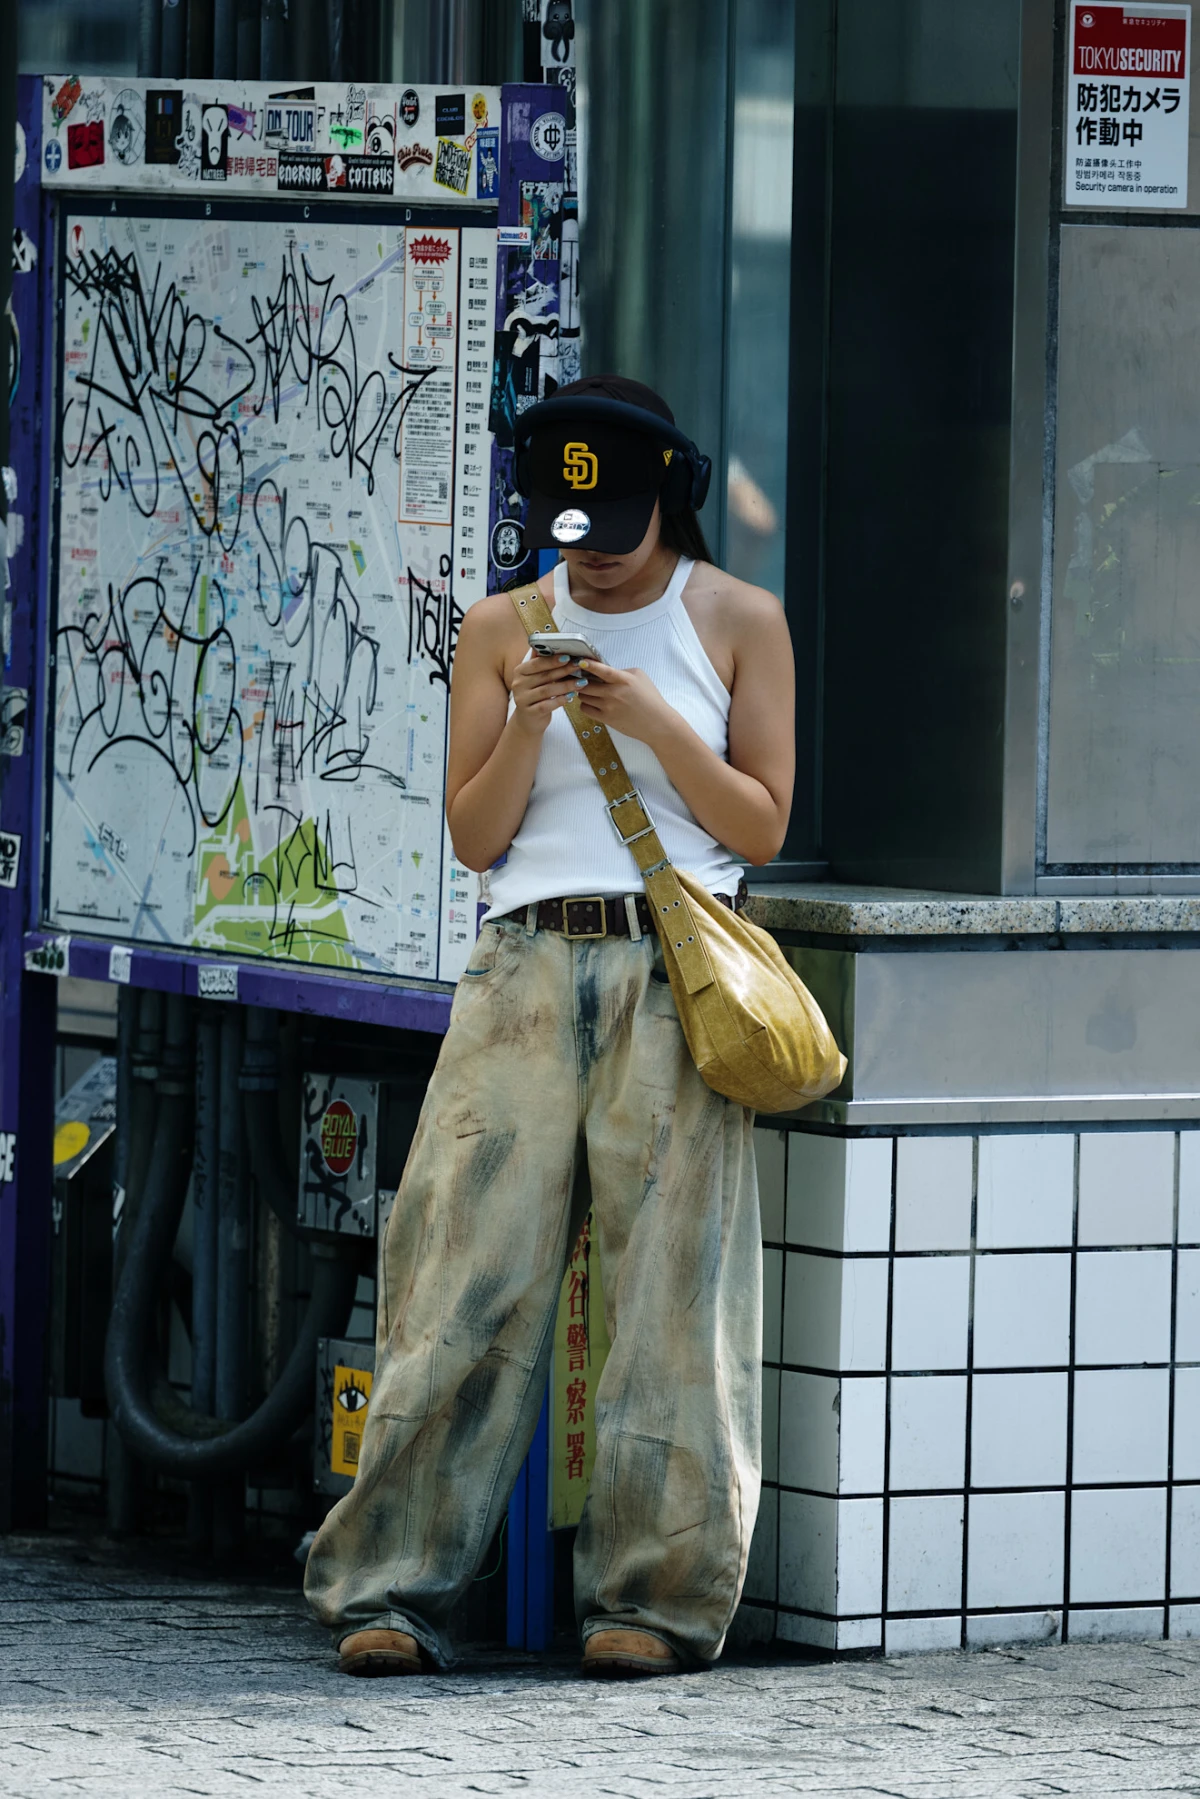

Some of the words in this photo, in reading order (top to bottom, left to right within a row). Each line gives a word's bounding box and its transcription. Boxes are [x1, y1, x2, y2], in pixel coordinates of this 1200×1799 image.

[1077, 83, 1181, 114] 防犯カメラ
[286, 110, 314, 142] TOUR
[1076, 117, 1143, 147] 作動中
[1075, 169, 1115, 180] 방범카메라
[1117, 171, 1142, 181] 작동중
[1075, 181, 1106, 192] Security
[1107, 184, 1134, 192] camera
[1135, 183, 1143, 193] in
[1143, 184, 1178, 194] operation
[110, 200, 117, 212] A
[205, 203, 212, 215] B
[303, 206, 310, 218] C
[405, 208, 412, 221] D
[563, 442, 598, 490] SD
[321, 1112, 357, 1137] ROYAL
[322, 1137, 353, 1158] BLUE
